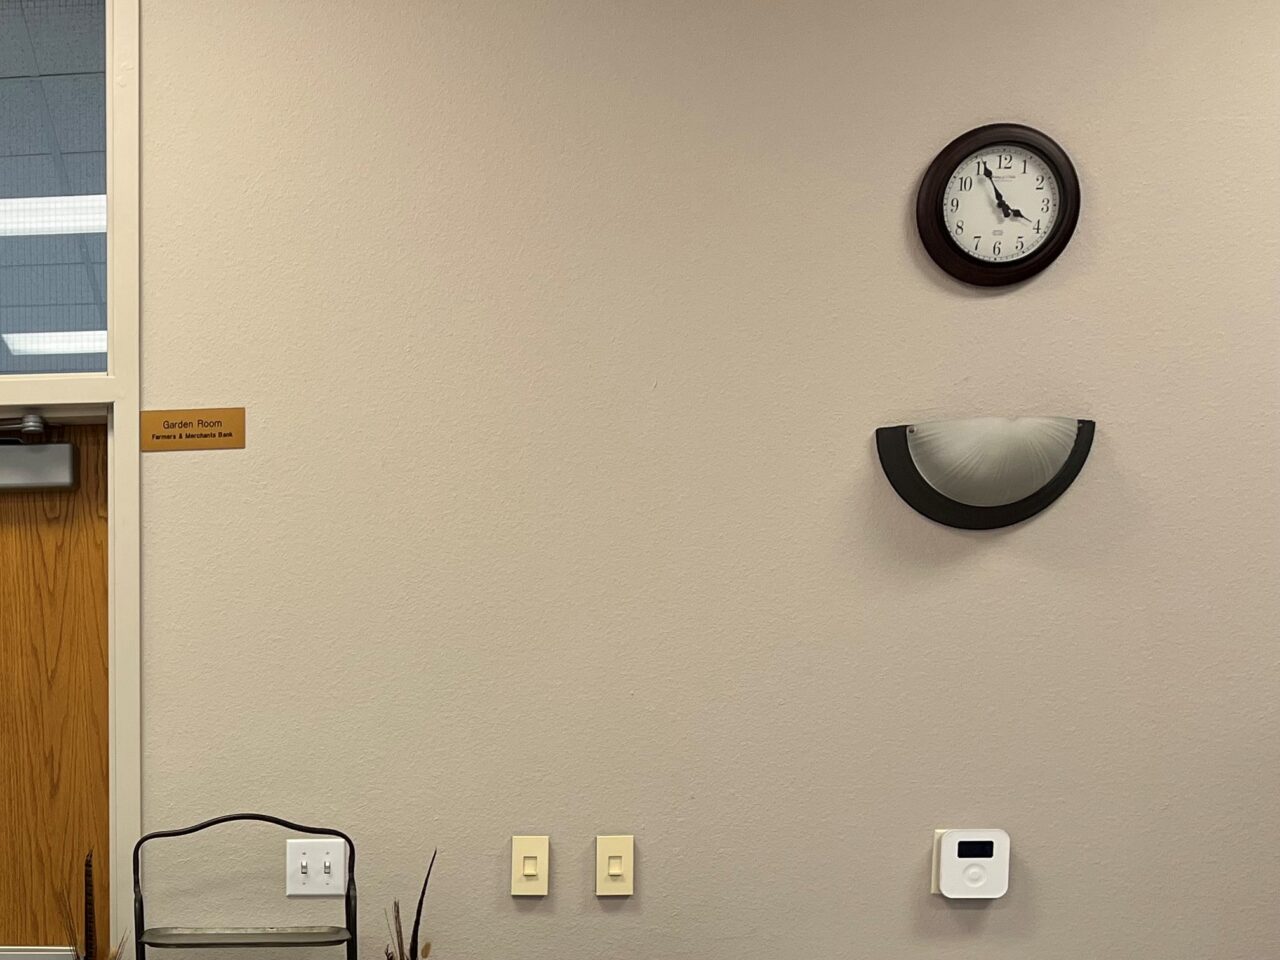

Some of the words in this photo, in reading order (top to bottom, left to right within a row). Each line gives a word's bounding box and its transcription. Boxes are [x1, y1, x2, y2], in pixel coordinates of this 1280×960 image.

[976, 160, 988, 175] 11
[997, 154, 1013, 169] 12
[1022, 159, 1027, 174] 1
[958, 176, 972, 191] 10
[1036, 175, 1044, 190] 2
[950, 198, 959, 212] 9
[1041, 198, 1050, 213] 3
[955, 220, 964, 234] 8
[1032, 219, 1041, 234] 4
[974, 236, 982, 251] 7
[992, 241, 1001, 256] 6
[1015, 236, 1024, 250] 5
[162, 420, 193, 430] Garden
[197, 419, 222, 428] Room
